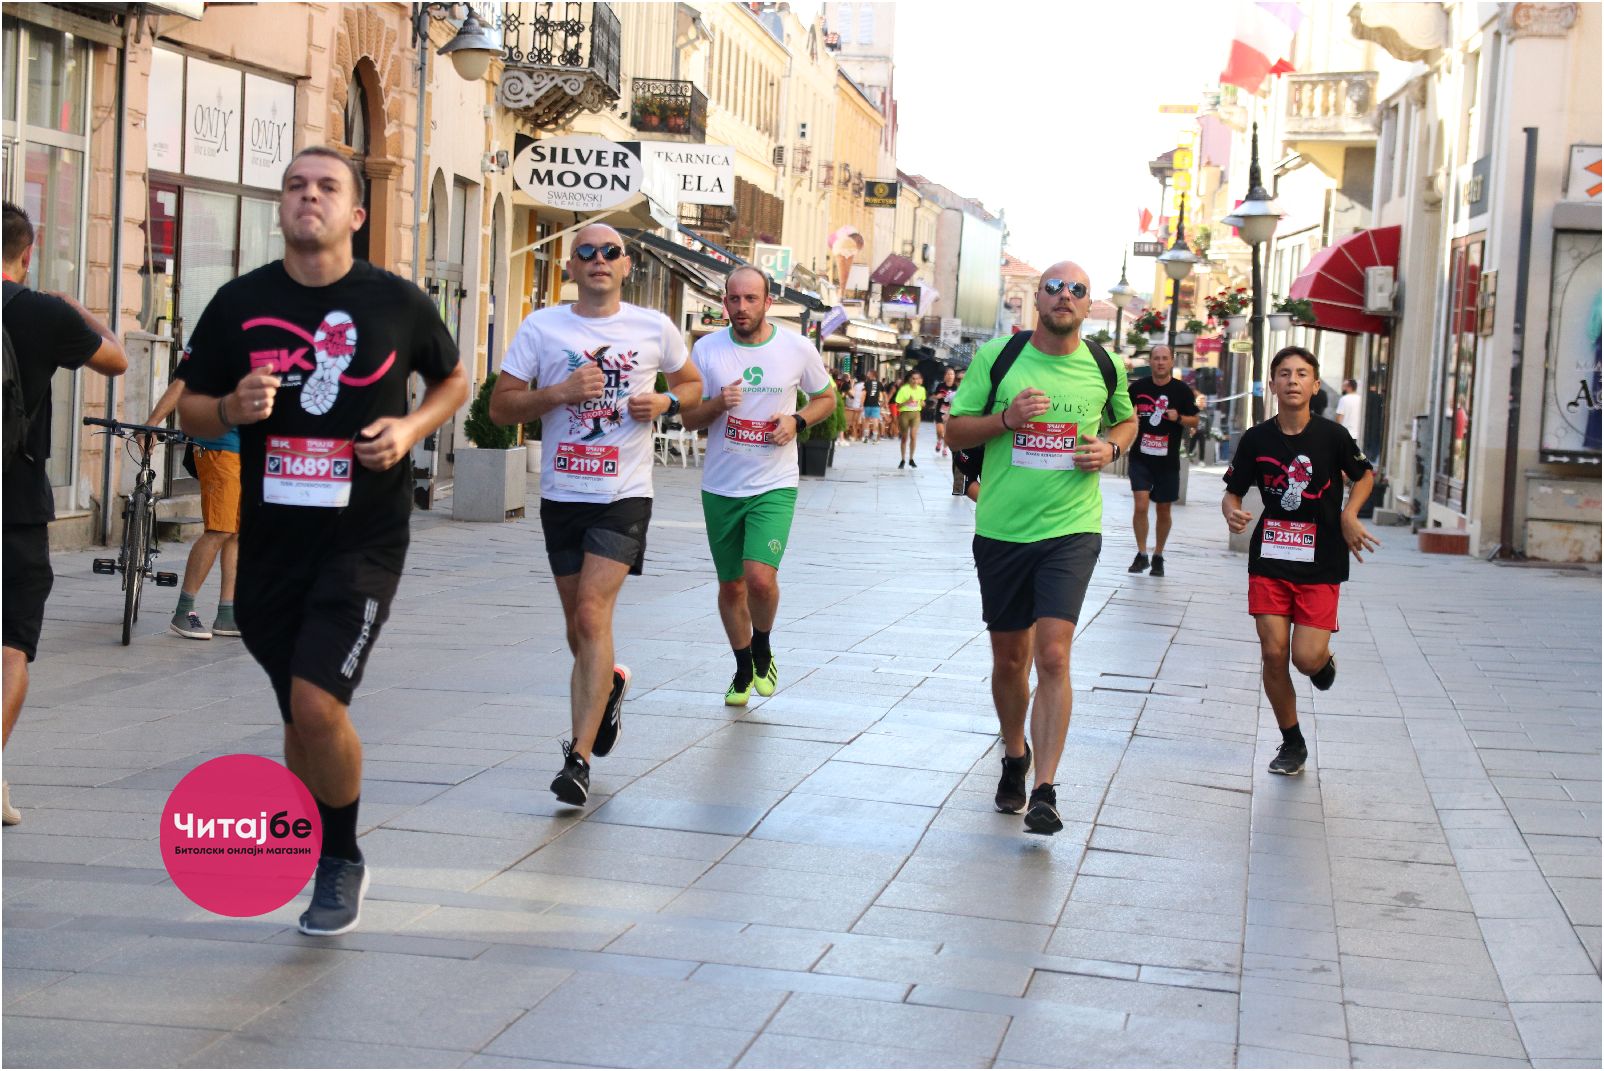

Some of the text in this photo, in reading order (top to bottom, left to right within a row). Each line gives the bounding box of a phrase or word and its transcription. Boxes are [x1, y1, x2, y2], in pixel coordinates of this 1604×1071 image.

[194, 104, 233, 154] ONIX
[251, 118, 287, 164] ONIX
[530, 145, 630, 169] SILVER
[529, 168, 631, 192] MOON
[677, 173, 725, 193] ELA
[547, 190, 603, 203] SWAROVSKI
[582, 410, 612, 420] SKOPJE
[737, 429, 763, 442] 1966
[1027, 435, 1063, 449] 2056
[283, 456, 330, 476] 1689
[570, 457, 600, 472] 2119
[1275, 531, 1302, 544] 2314
